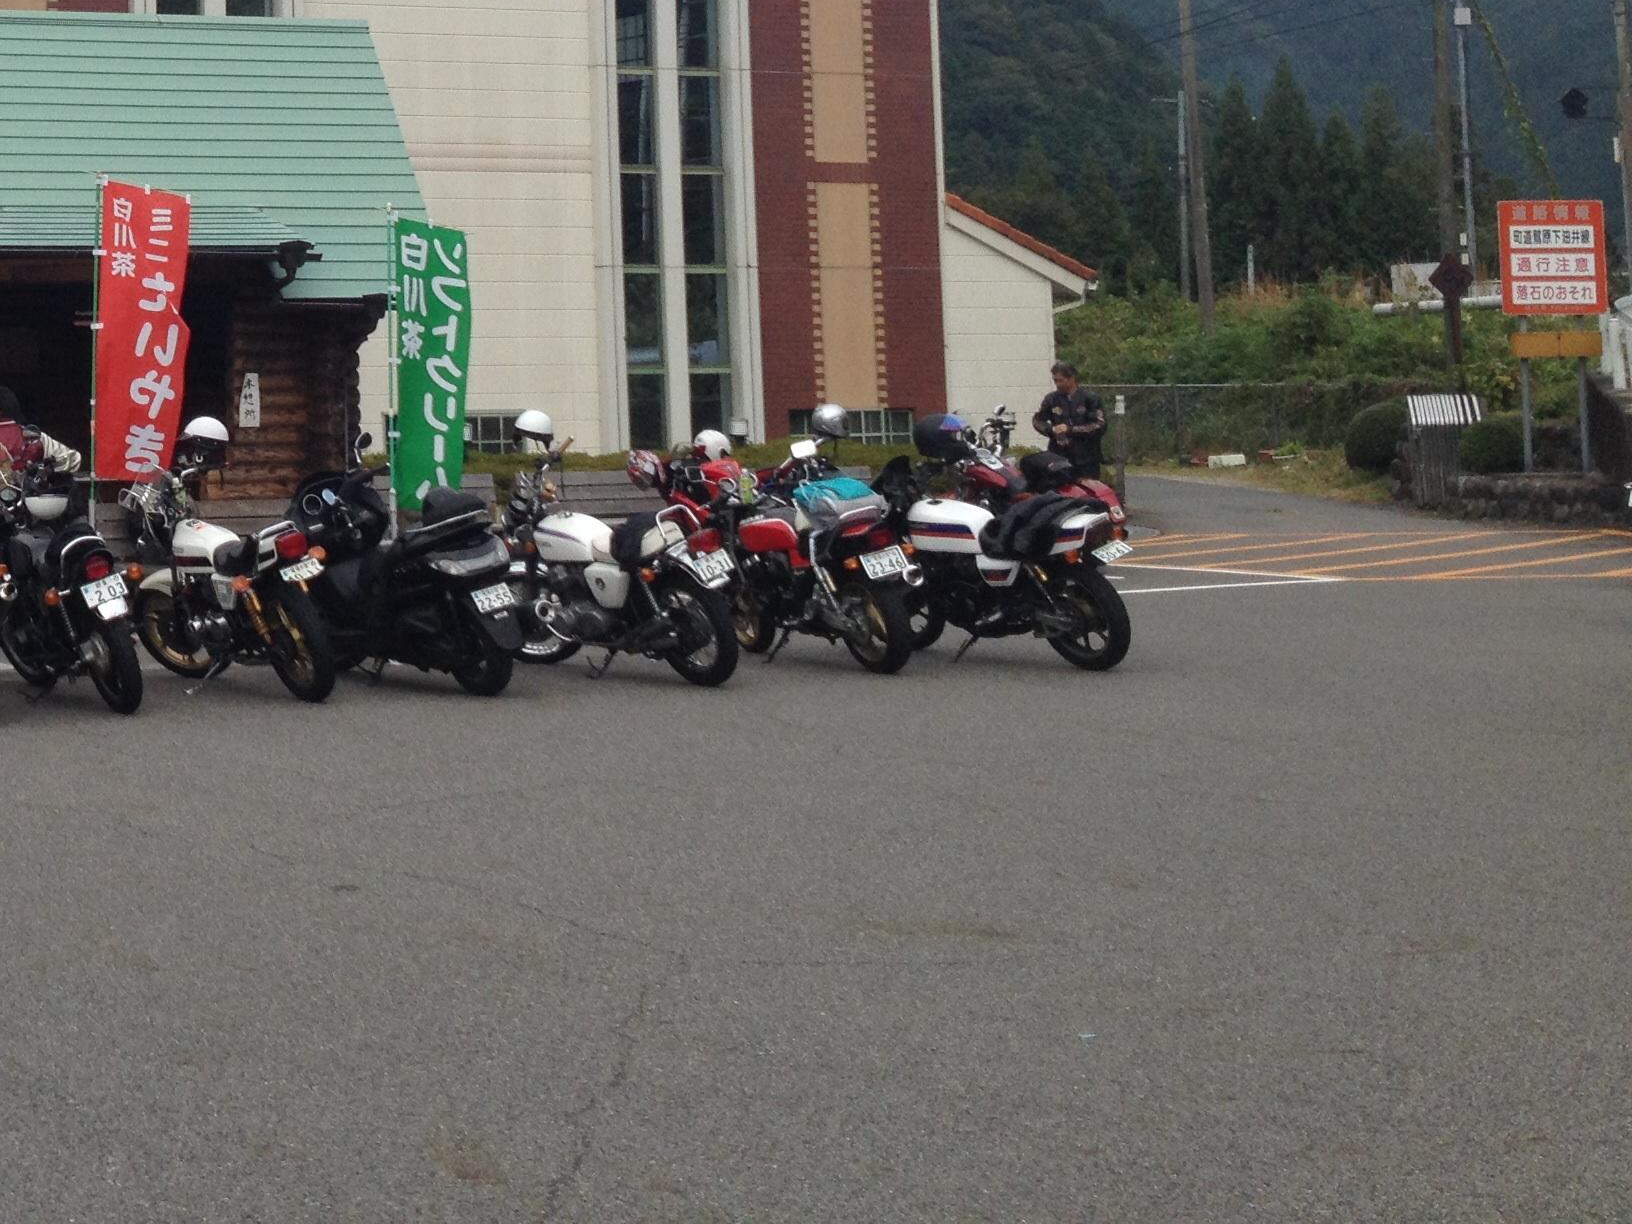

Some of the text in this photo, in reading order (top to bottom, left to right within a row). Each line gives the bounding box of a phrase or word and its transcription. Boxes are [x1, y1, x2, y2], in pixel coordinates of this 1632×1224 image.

[1517, 257, 1590, 273] 通行注意
[1516, 285, 1593, 301] 落石のおそれ
